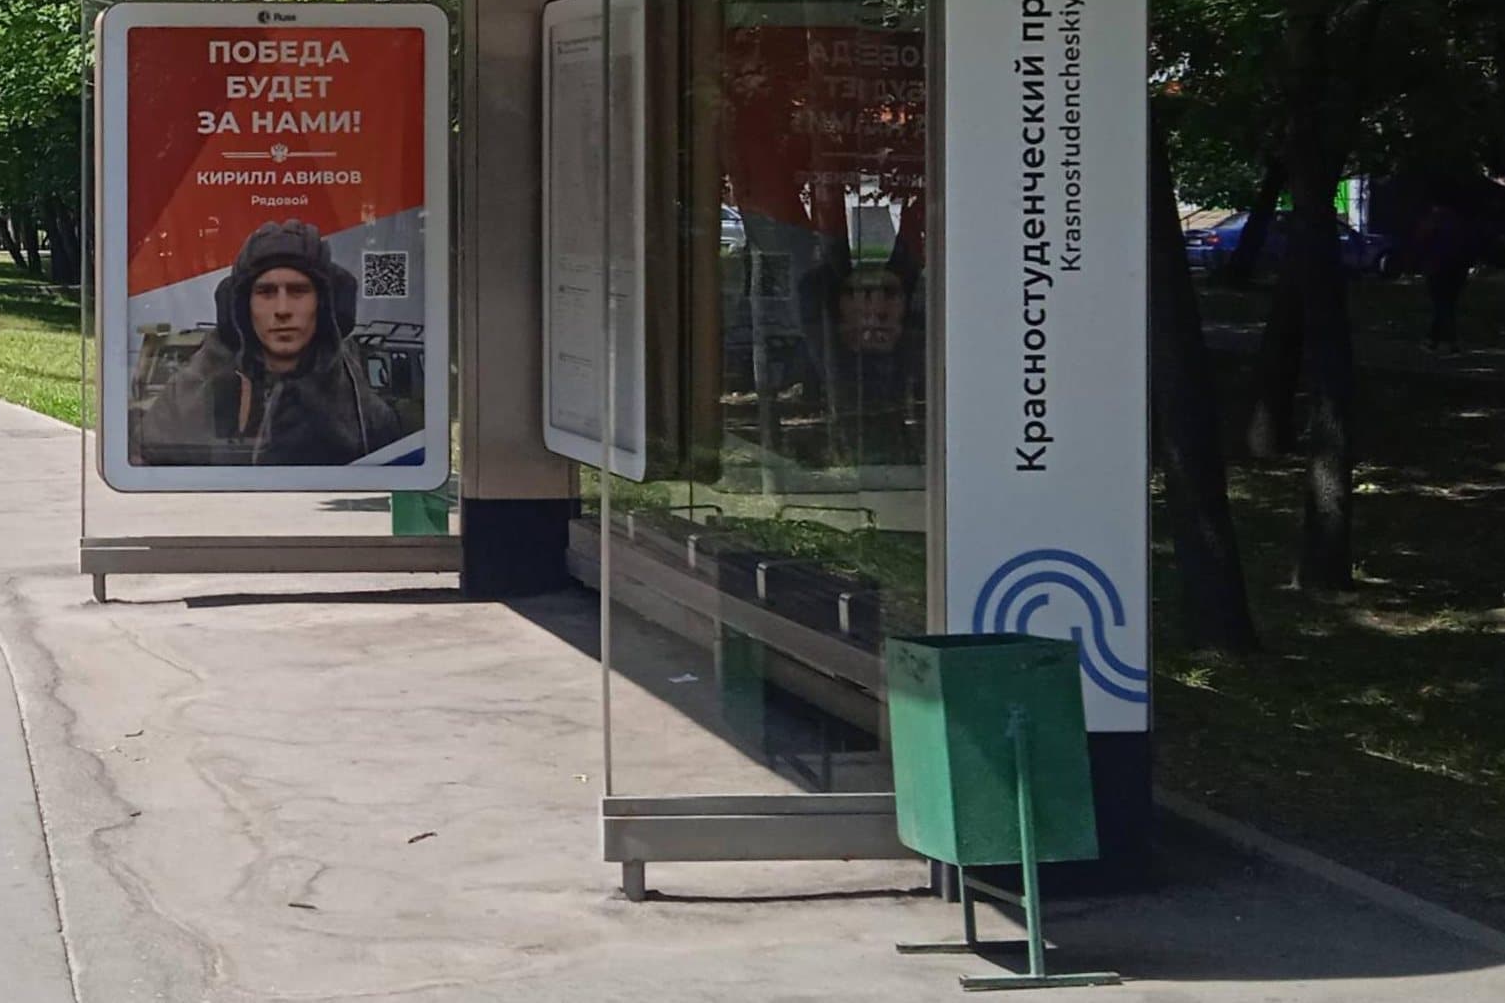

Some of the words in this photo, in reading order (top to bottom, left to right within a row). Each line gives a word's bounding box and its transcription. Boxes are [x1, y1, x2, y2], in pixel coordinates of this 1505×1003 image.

[208, 40, 350, 67] ПОБЕДА
[226, 76, 334, 102] БУДЕТ
[197, 111, 240, 134] ЗА
[252, 111, 362, 134] НАМИ!
[196, 171, 277, 186] КИРИЛЛ
[282, 170, 362, 185] АВИВОВ
[251, 194, 309, 208] Рядовой
[1014, 55, 1054, 471] Красностуденческий
